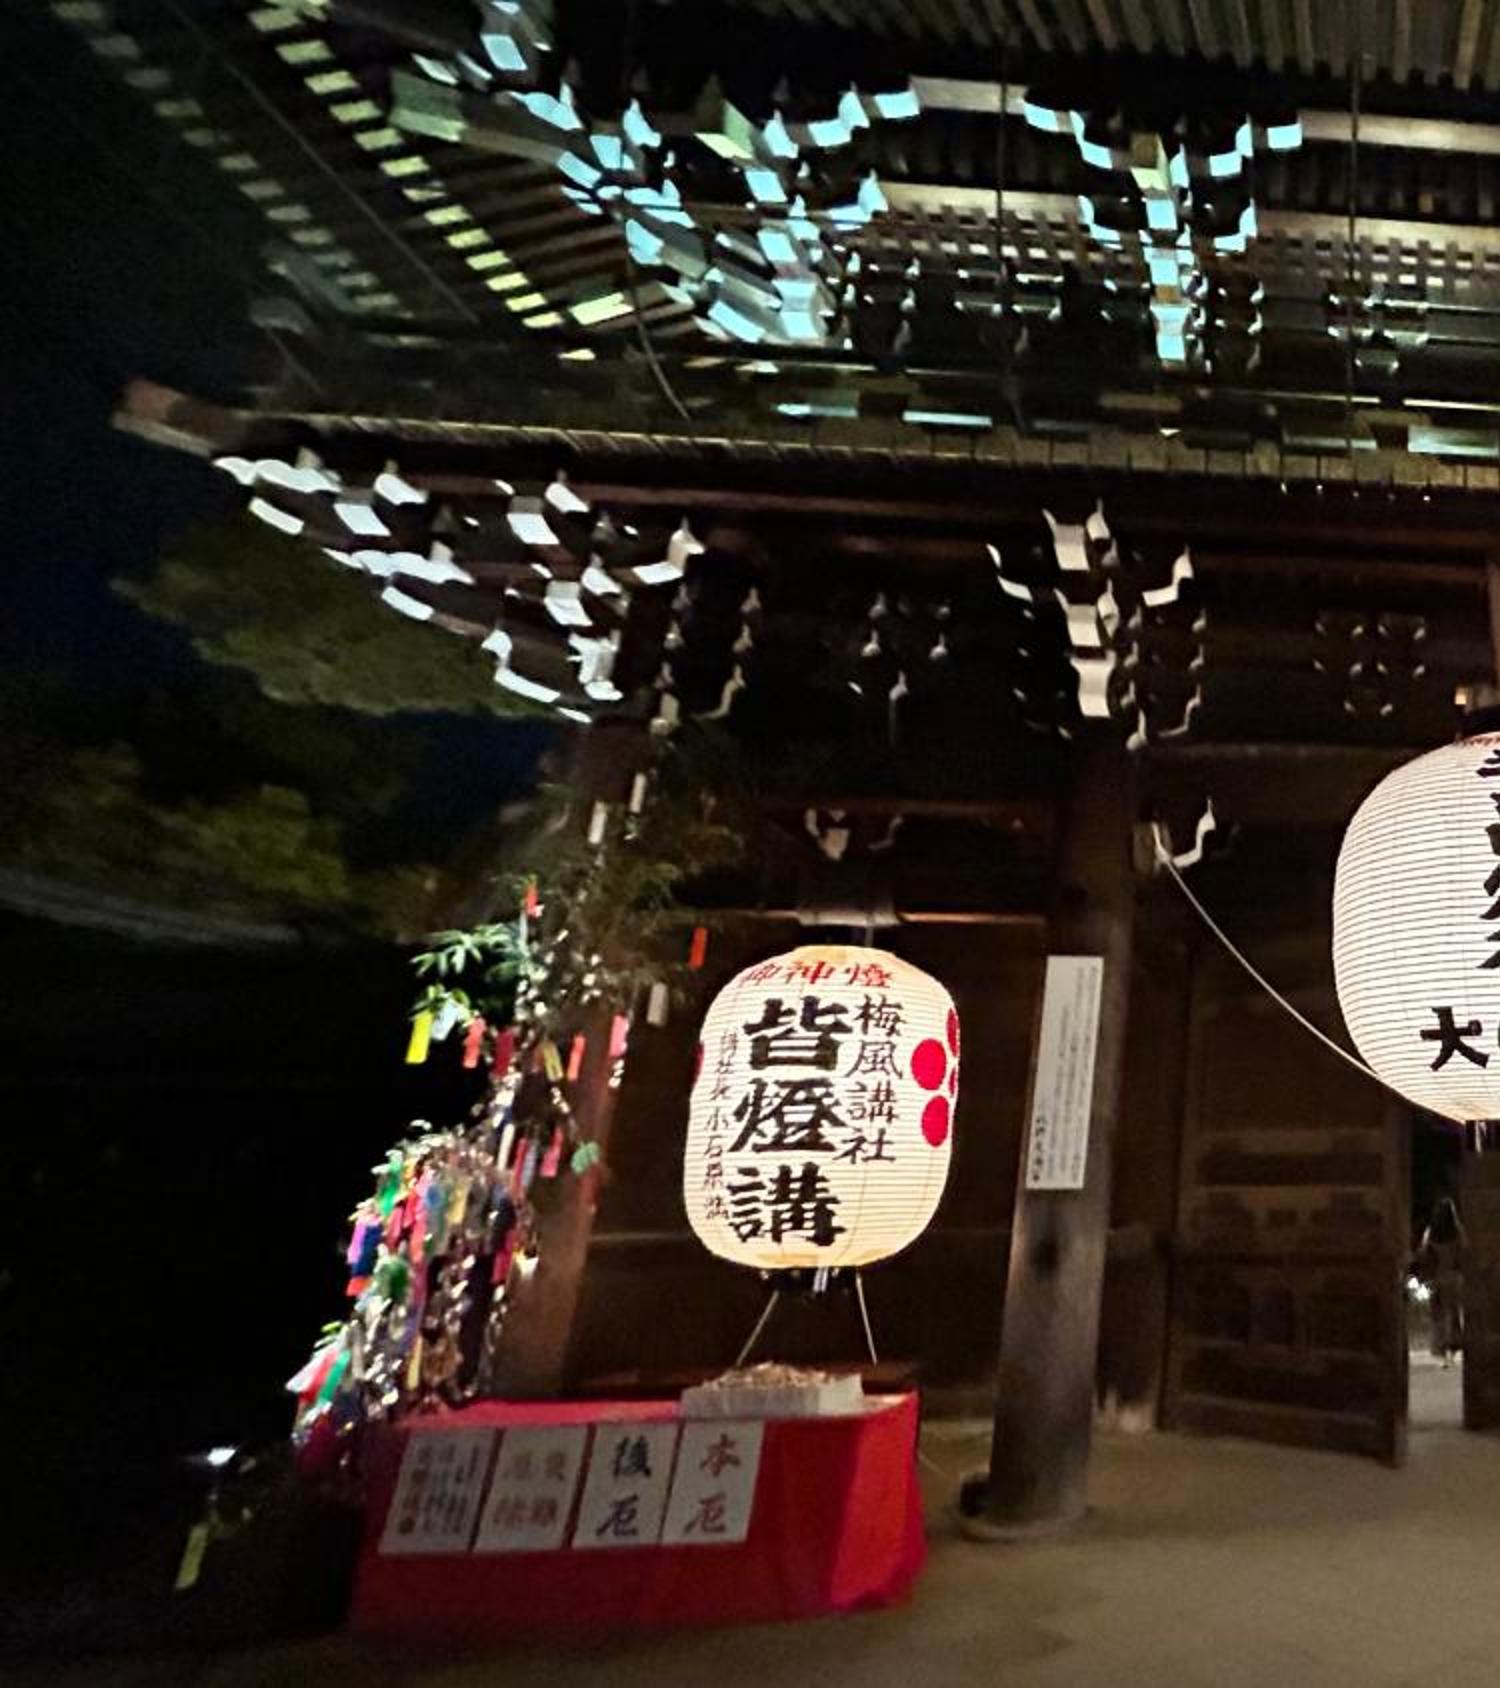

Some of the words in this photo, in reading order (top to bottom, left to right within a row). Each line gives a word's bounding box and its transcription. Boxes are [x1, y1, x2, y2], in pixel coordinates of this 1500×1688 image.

[739, 961, 892, 989] 御神燈
[727, 995, 853, 1246] 皆燈講
[832, 994, 906, 1164] 梅風講社
[596, 1436, 651, 1536] 後厄
[684, 1433, 741, 1534] 本厄
